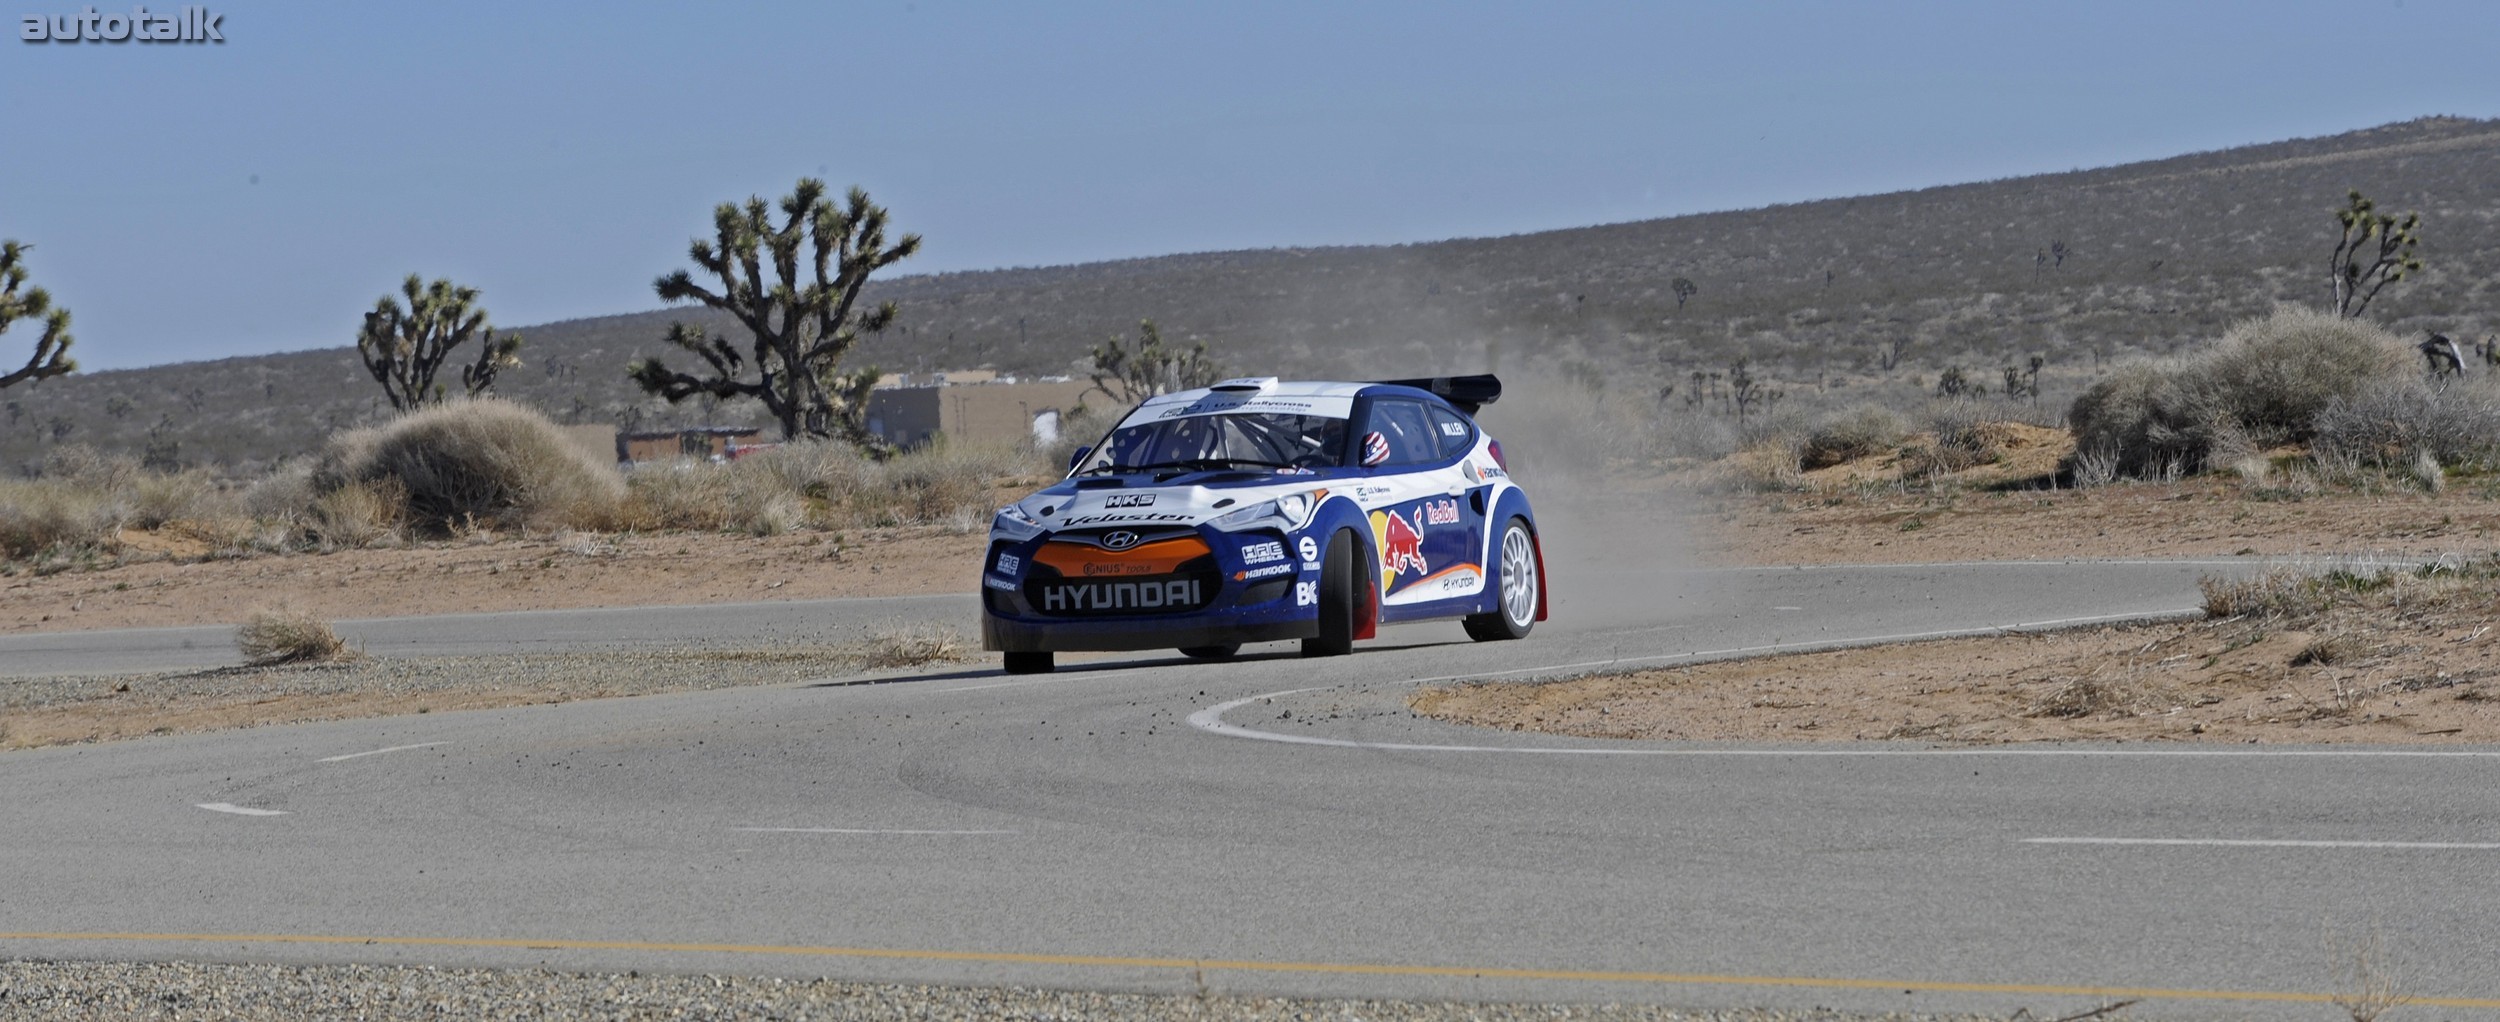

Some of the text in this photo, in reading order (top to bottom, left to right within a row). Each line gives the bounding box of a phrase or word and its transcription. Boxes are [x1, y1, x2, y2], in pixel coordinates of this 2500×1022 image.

[1104, 494, 1157, 509] HKS
[1061, 513, 1196, 527] Veloster
[1241, 541, 1284, 560] HRE
[1244, 554, 1285, 566] WHEELS
[1450, 576, 1475, 590] HYUNDAI
[1044, 579, 1201, 611] HYUNDAI
